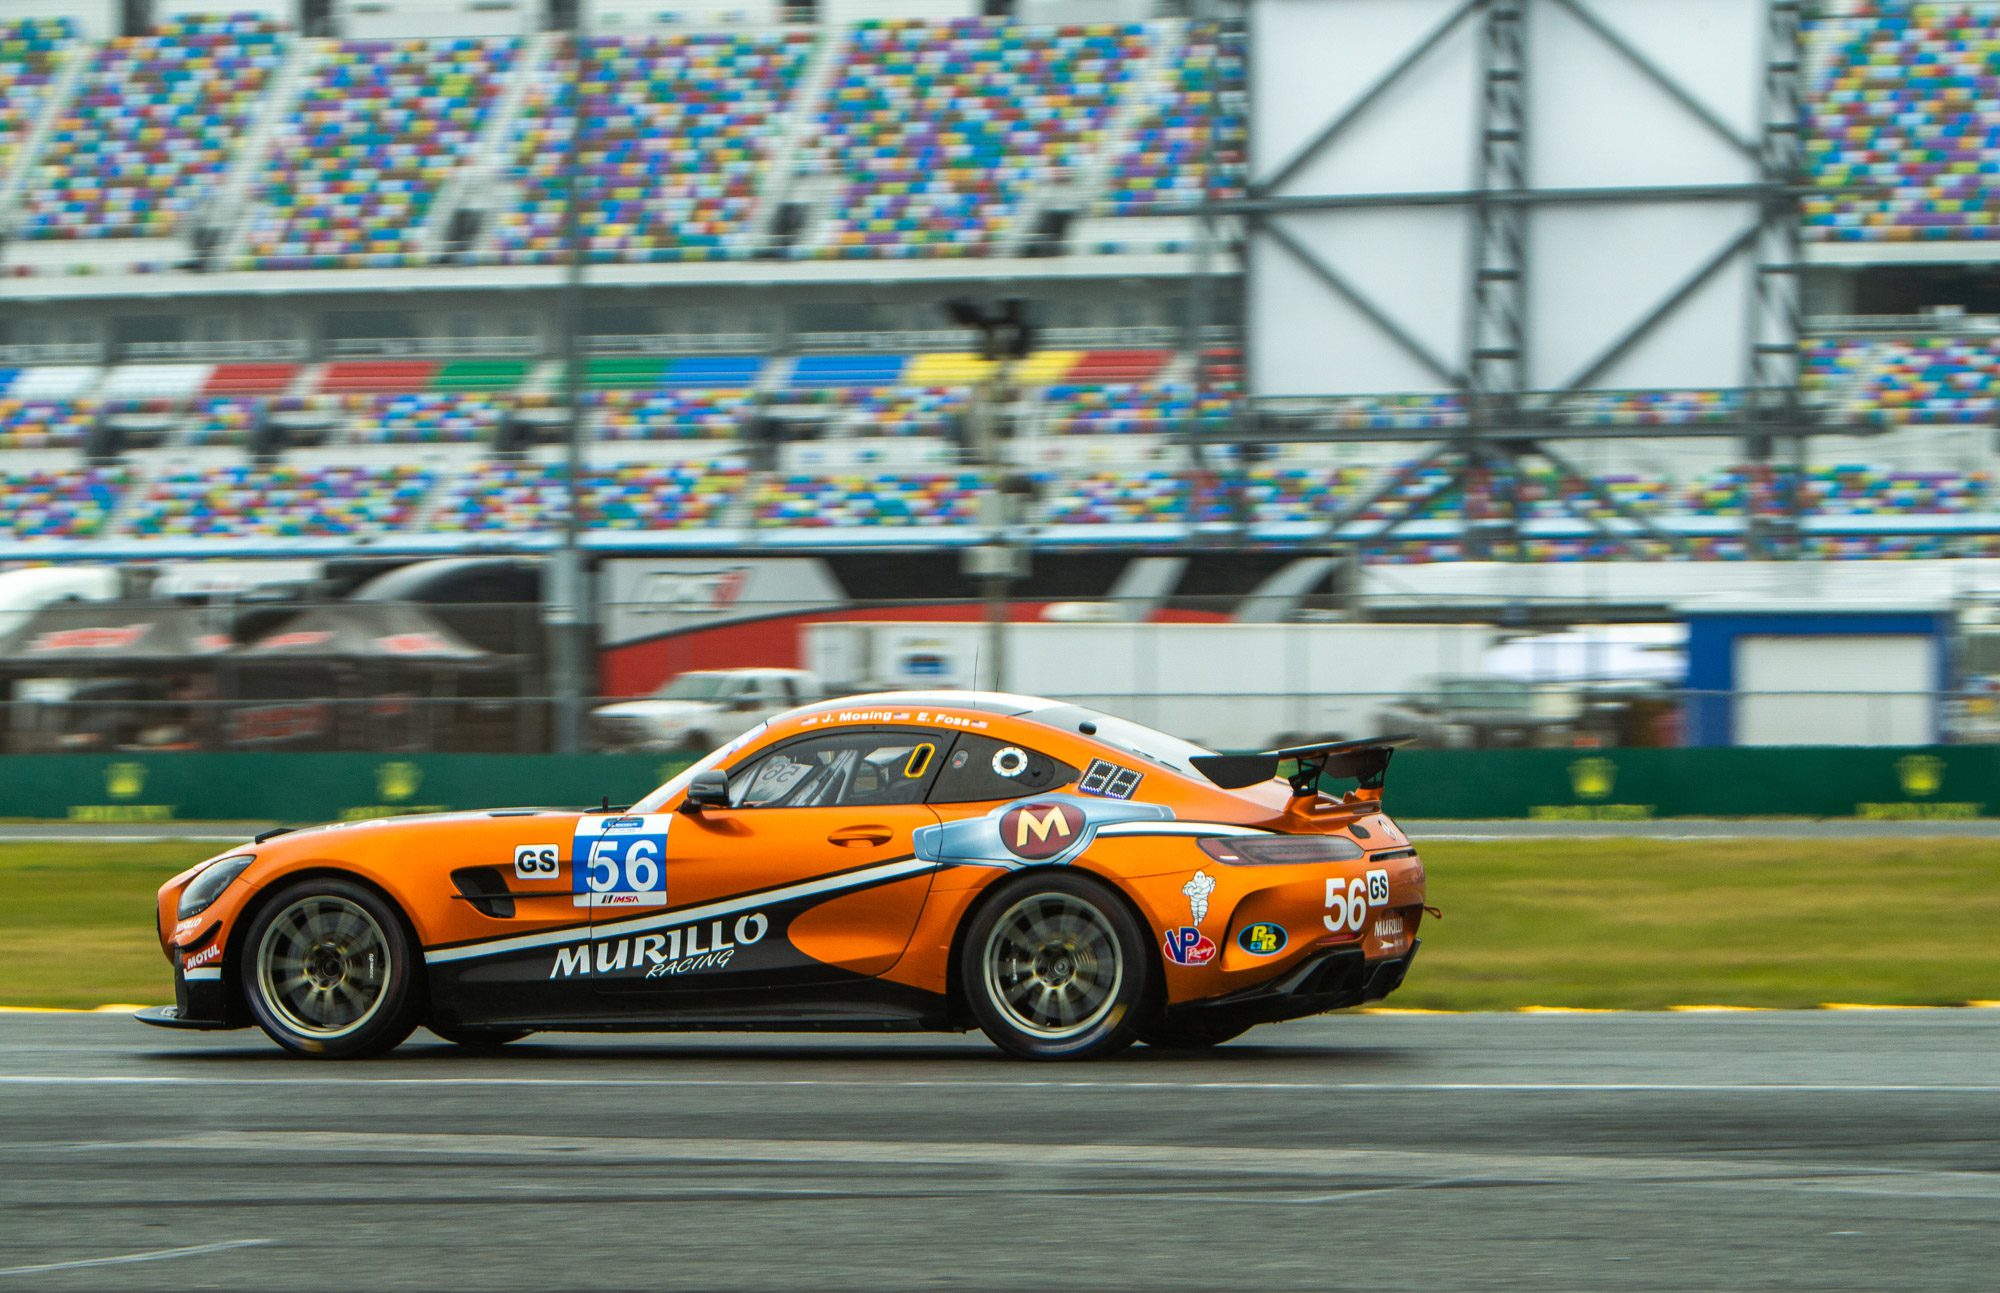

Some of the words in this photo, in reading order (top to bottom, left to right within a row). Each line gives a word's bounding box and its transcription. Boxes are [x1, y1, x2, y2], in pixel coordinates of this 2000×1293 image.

[822, 714, 832, 723] J.
[839, 711, 893, 722] Mosing
[917, 712, 931, 722] E.
[935, 714, 972, 726] Foss
[1016, 805, 1072, 848] M
[517, 849, 556, 873] GS
[586, 839, 659, 893] 56
[613, 895, 640, 903] IMSA
[1369, 875, 1388, 900] GS
[1322, 878, 1367, 932] 56
[187, 944, 221, 969] MOTUL
[550, 912, 769, 979] MURILLO
[1165, 927, 1201, 963] VP
[645, 949, 735, 979] RACING
